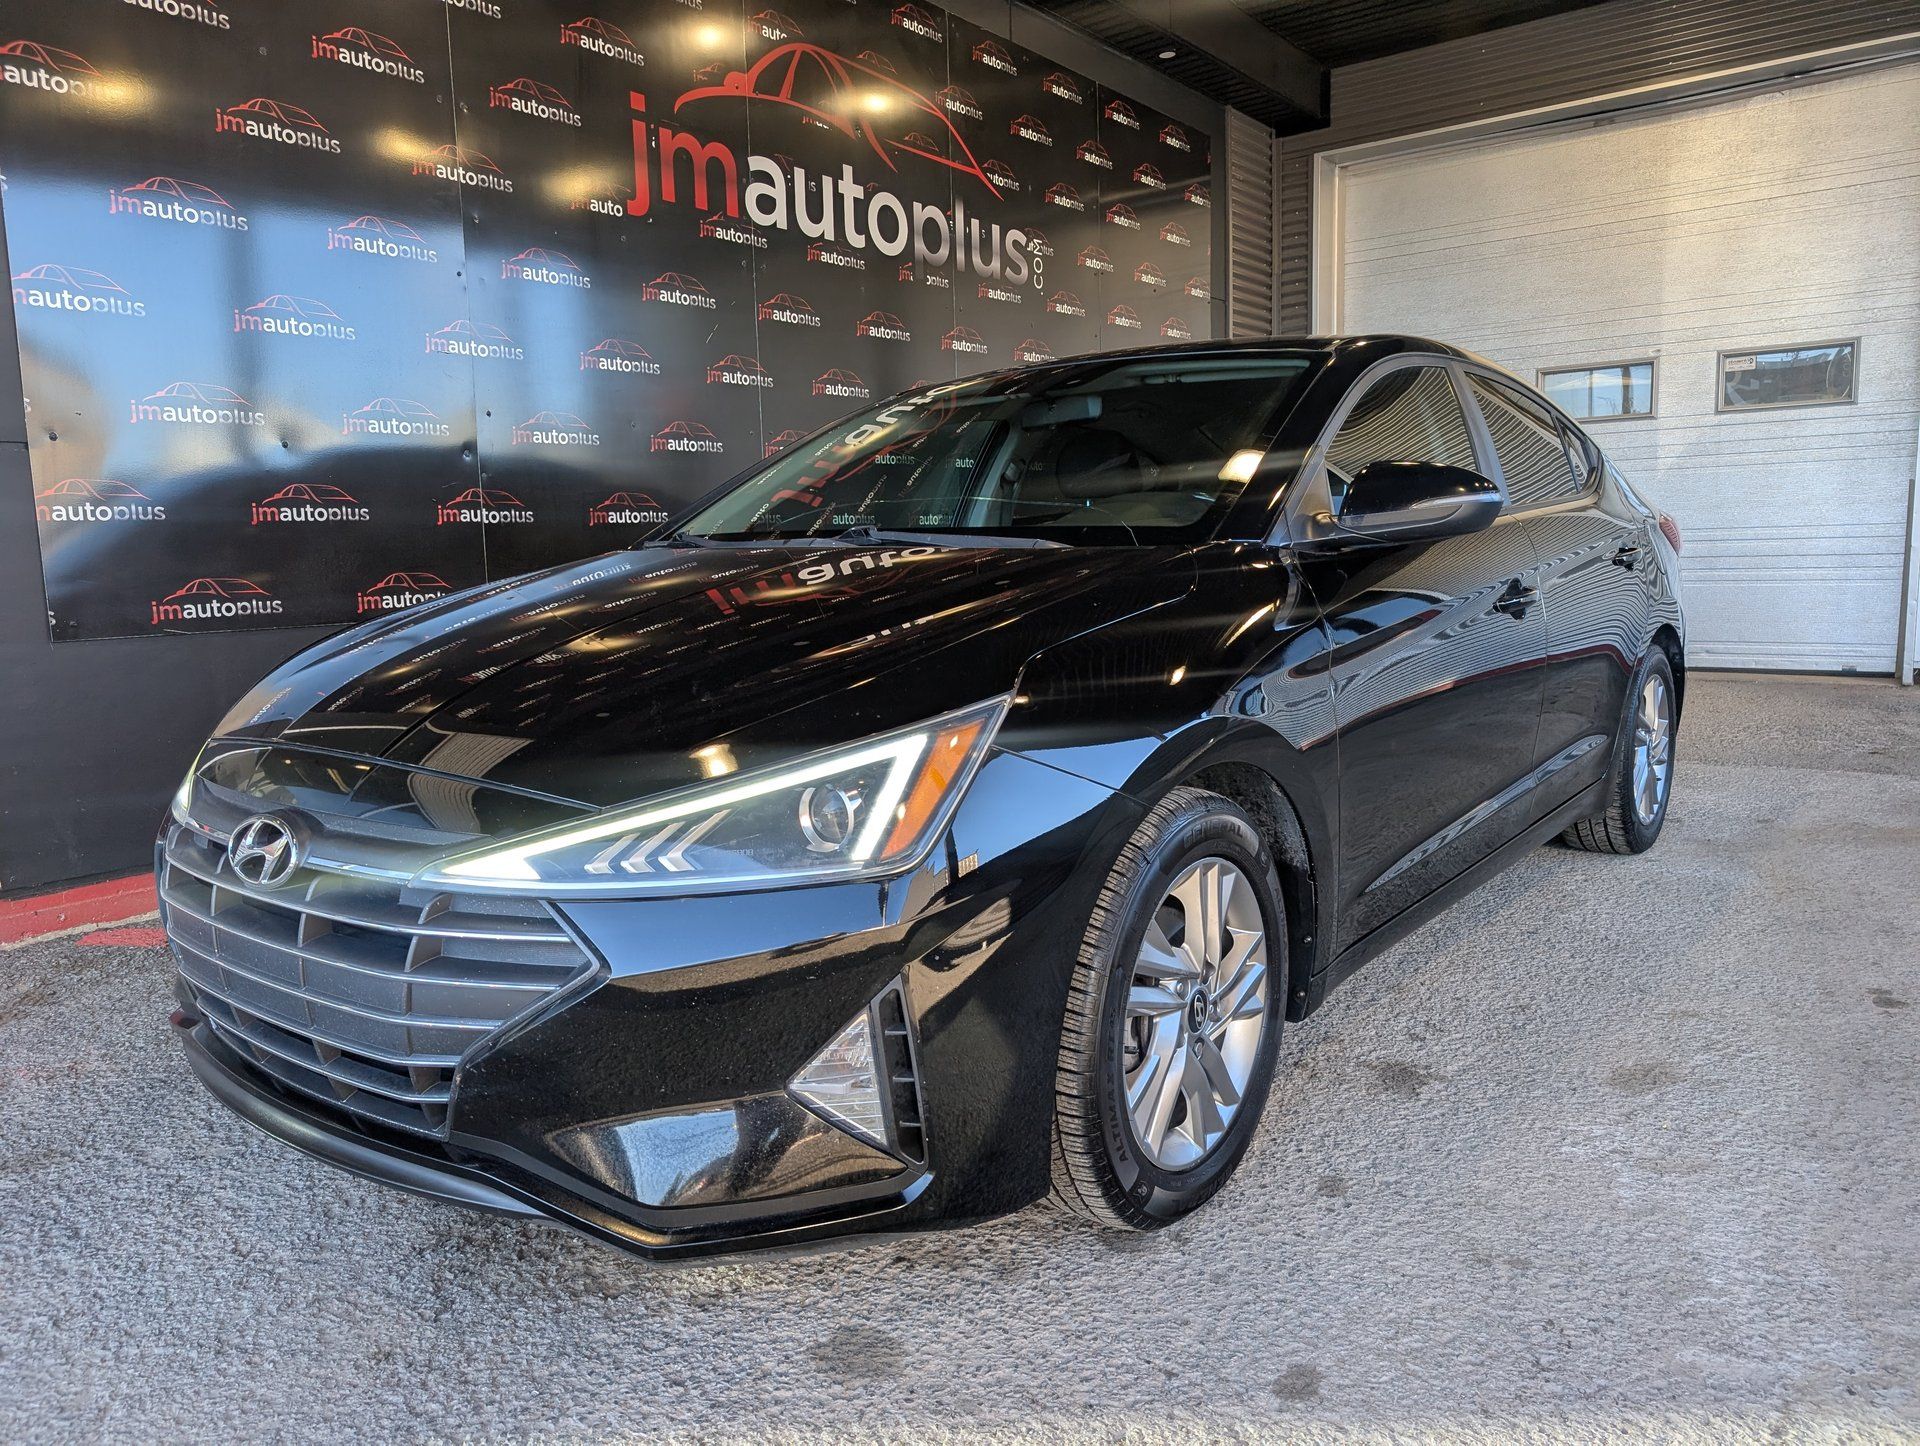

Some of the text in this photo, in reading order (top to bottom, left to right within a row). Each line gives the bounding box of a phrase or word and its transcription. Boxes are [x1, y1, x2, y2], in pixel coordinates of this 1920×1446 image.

[891, 8, 943, 43] jmautoplus
[560, 24, 645, 67] jmautoplus
[311, 35, 425, 84] jmautoplus
[972, 46, 1018, 76] jmautoplus
[1043, 77, 1083, 105] jmautoplus
[490, 87, 582, 127] jmautoplus
[935, 90, 983, 121] jmautoplus
[1104, 105, 1140, 131] jmautoplus
[216, 108, 341, 154] jmautoplus
[1010, 119, 1053, 148] jmautoplus
[1159, 129, 1191, 153] jmautoplus
[1076, 143, 1113, 170] jmautoplus
[412, 158, 513, 193] jmautoplus
[627, 90, 1029, 286] jmautoplus
[1133, 167, 1167, 191] jmautoplus
[109, 189, 249, 232] jmautoplus
[1045, 190, 1085, 213] jmautoplus
[1106, 209, 1141, 231] jmautoplus
[327, 228, 438, 263] jmautoplus
[700, 219, 768, 249] jmautoplus
[1159, 228, 1191, 248] jmautoplus
[807, 245, 866, 271] jmautoplus
[1077, 251, 1114, 273] jmautoplus
[501, 260, 591, 289] jmautoplus
[1134, 269, 1167, 288] jmautoplus
[642, 283, 717, 310] jmautoplus
[978, 283, 1022, 304] jmautoplus
[758, 303, 821, 328] jmautoplus
[1046, 297, 1086, 318] jmautoplus
[1107, 310, 1142, 330] jmautoplus
[234, 309, 356, 341] jmautoplus
[856, 320, 911, 342] jmautoplus
[1160, 324, 1192, 340] jmautoplus
[425, 333, 524, 360] jmautoplus
[941, 335, 988, 354] jmautoplus
[580, 352, 661, 375] jmautoplus
[706, 366, 774, 388] jmautoplus
[812, 379, 870, 399] jmautoplus
[130, 399, 265, 426] jmautoplus
[342, 413, 450, 437] jmautoplus
[512, 425, 600, 446] jmautoplus
[650, 434, 723, 453] jmautoplus
[251, 502, 370, 525] jmautoplus
[437, 505, 534, 527] jmautoplus
[589, 507, 669, 527] jmautoplus
[151, 598, 283, 624] jmautoplus
[1106, 1073, 1129, 1162] ALTIMAX
